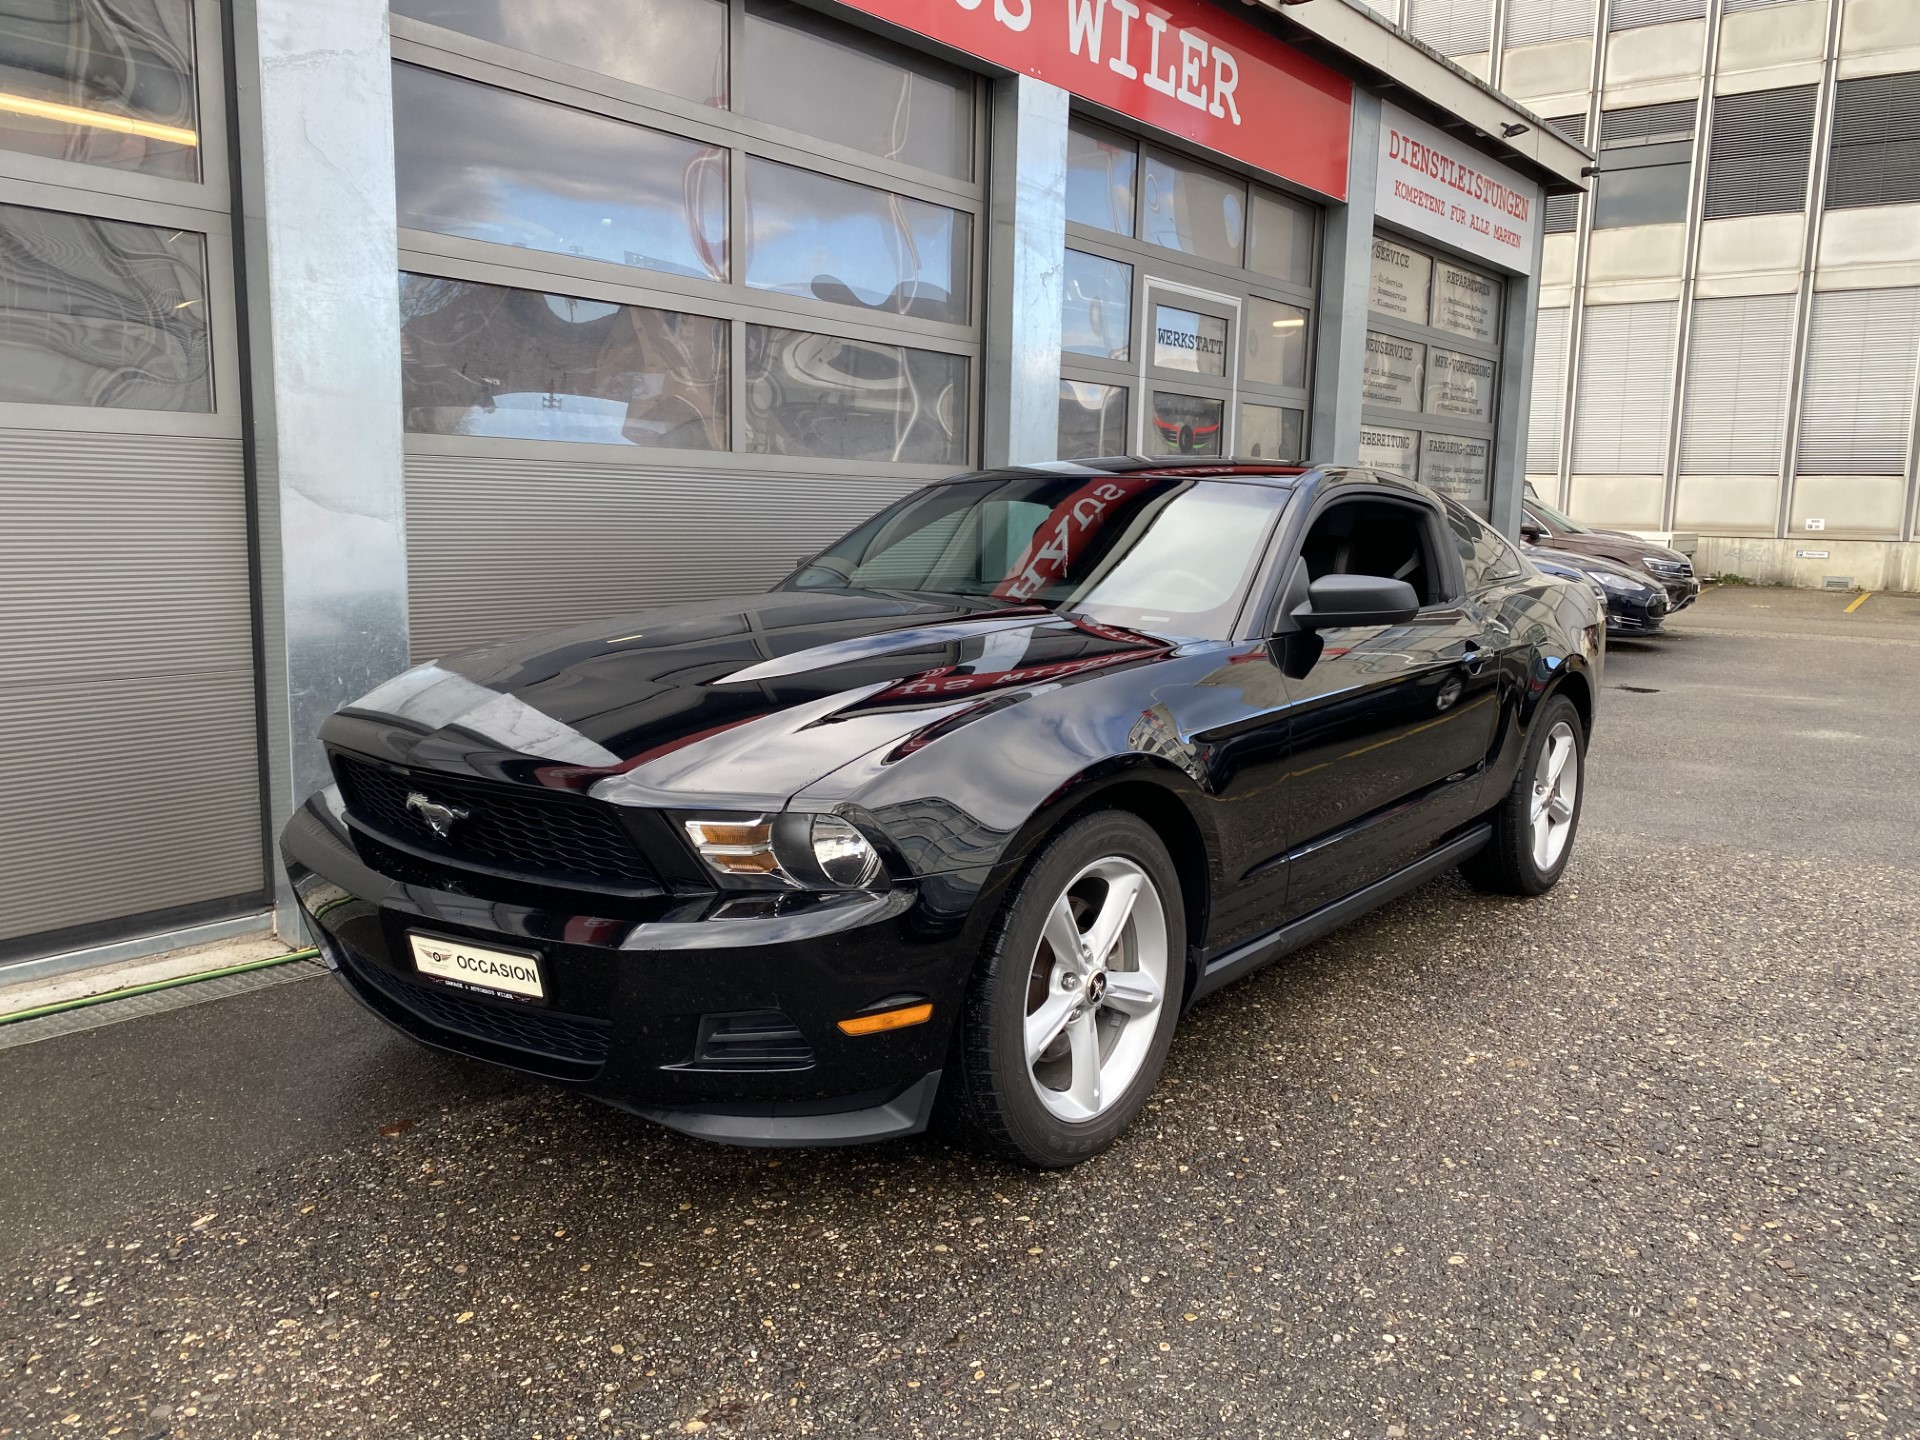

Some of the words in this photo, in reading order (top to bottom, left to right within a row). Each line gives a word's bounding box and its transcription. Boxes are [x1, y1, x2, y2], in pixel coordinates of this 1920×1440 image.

[1068, 0, 1242, 126] WILER
[1389, 129, 1530, 223] DIENSTLEISTUNGEN
[1394, 179, 1446, 217] KOMPETENZ
[1450, 202, 1466, 226] FÜR
[1469, 214, 1490, 236] ALLE
[1493, 224, 1522, 249] MARKEN
[1375, 244, 1410, 268] SERVICE
[1446, 270, 1491, 296] REPARATUREN
[1157, 327, 1223, 355] WERKSTATT
[456, 955, 537, 983] OCCASION
